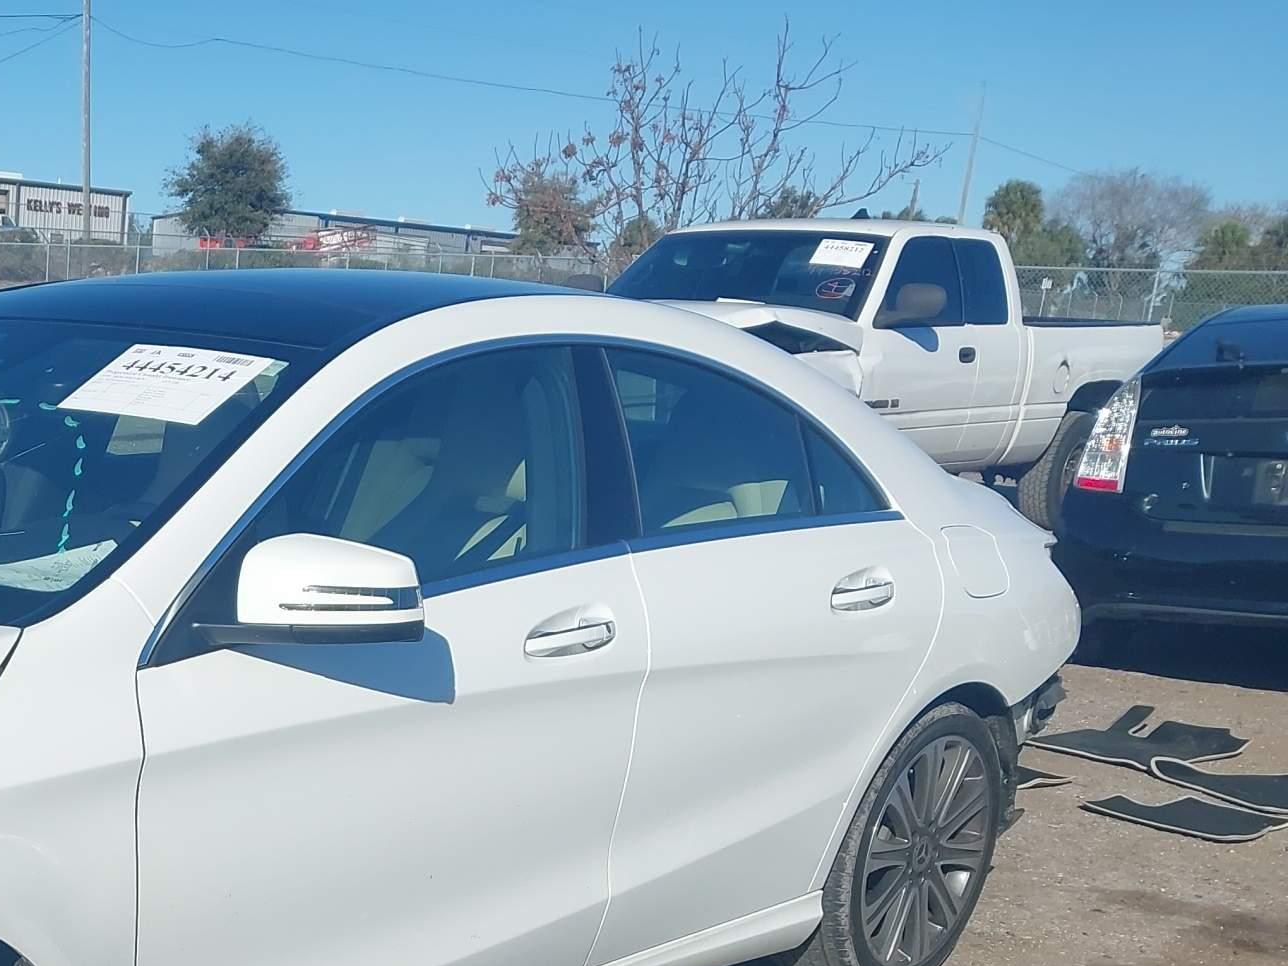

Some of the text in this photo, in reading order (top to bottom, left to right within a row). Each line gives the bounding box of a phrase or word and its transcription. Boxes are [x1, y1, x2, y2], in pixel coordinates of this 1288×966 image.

[26, 198, 110, 218] KELLY'S WEING
[122, 359, 237, 382] 44454214
